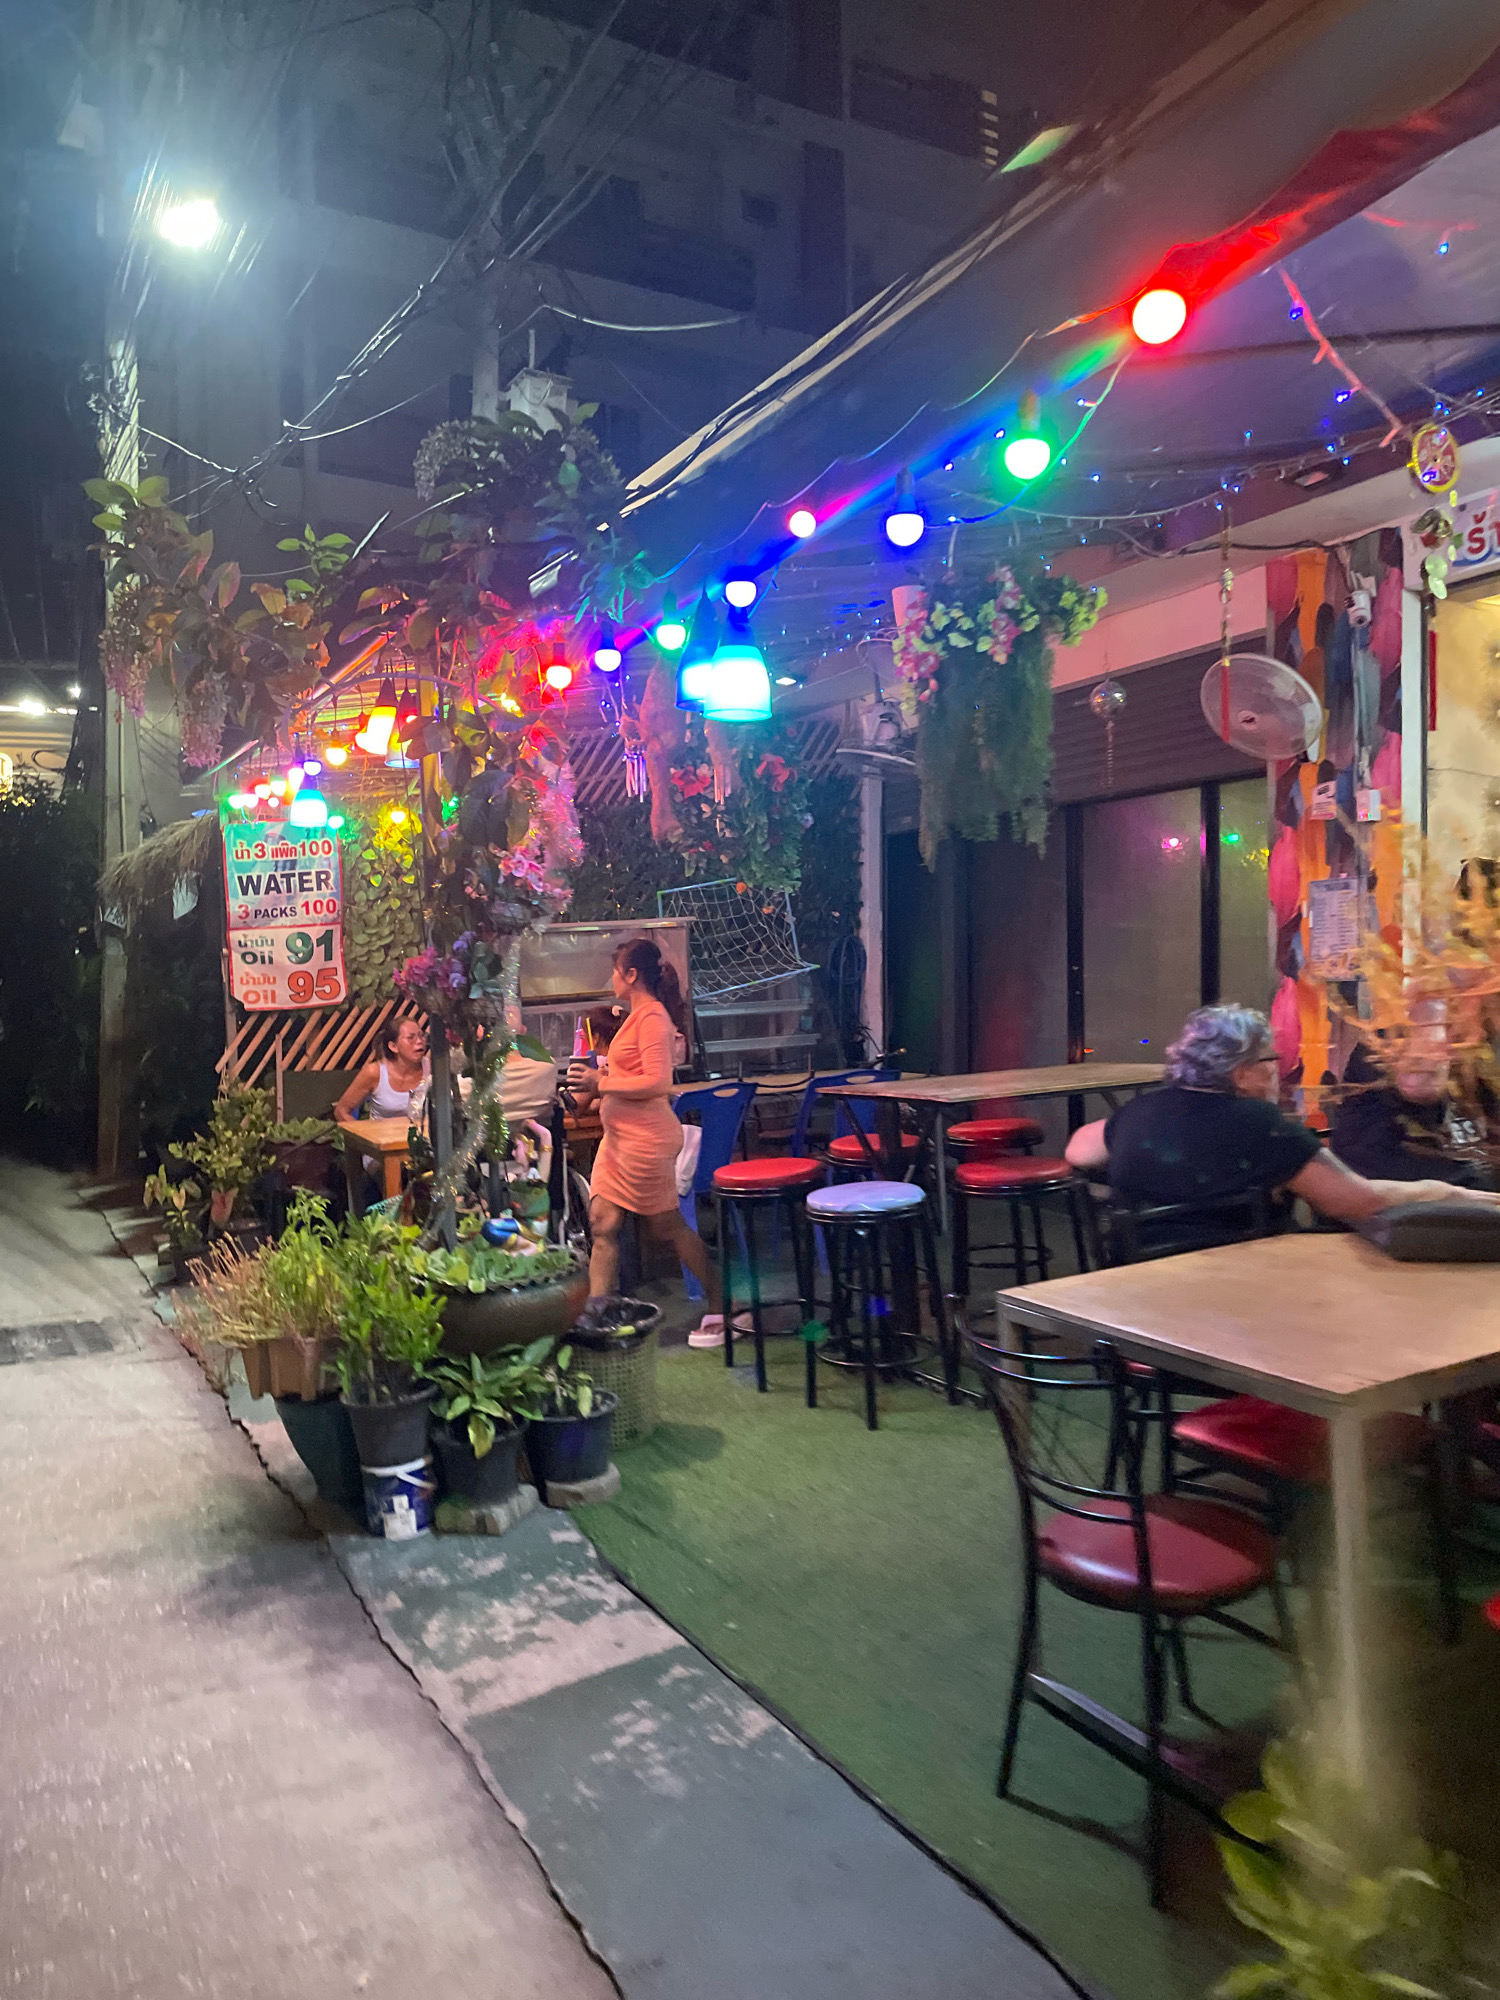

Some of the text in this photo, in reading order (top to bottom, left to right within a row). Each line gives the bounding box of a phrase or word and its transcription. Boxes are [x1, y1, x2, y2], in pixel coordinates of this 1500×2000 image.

[235, 841, 250, 860] น้ำ
[254, 842, 267, 859] 3
[299, 840, 332, 857] 100
[237, 870, 334, 896] WATER
[237, 898, 337, 920] 3 PACKS 100
[238, 933, 275, 948] น้ำมัน
[285, 929, 334, 965] 91
[240, 950, 274, 965] Oil
[240, 971, 277, 986] น้ำมัน
[287, 967, 341, 1004] 95
[242, 989, 277, 1005] Oil
